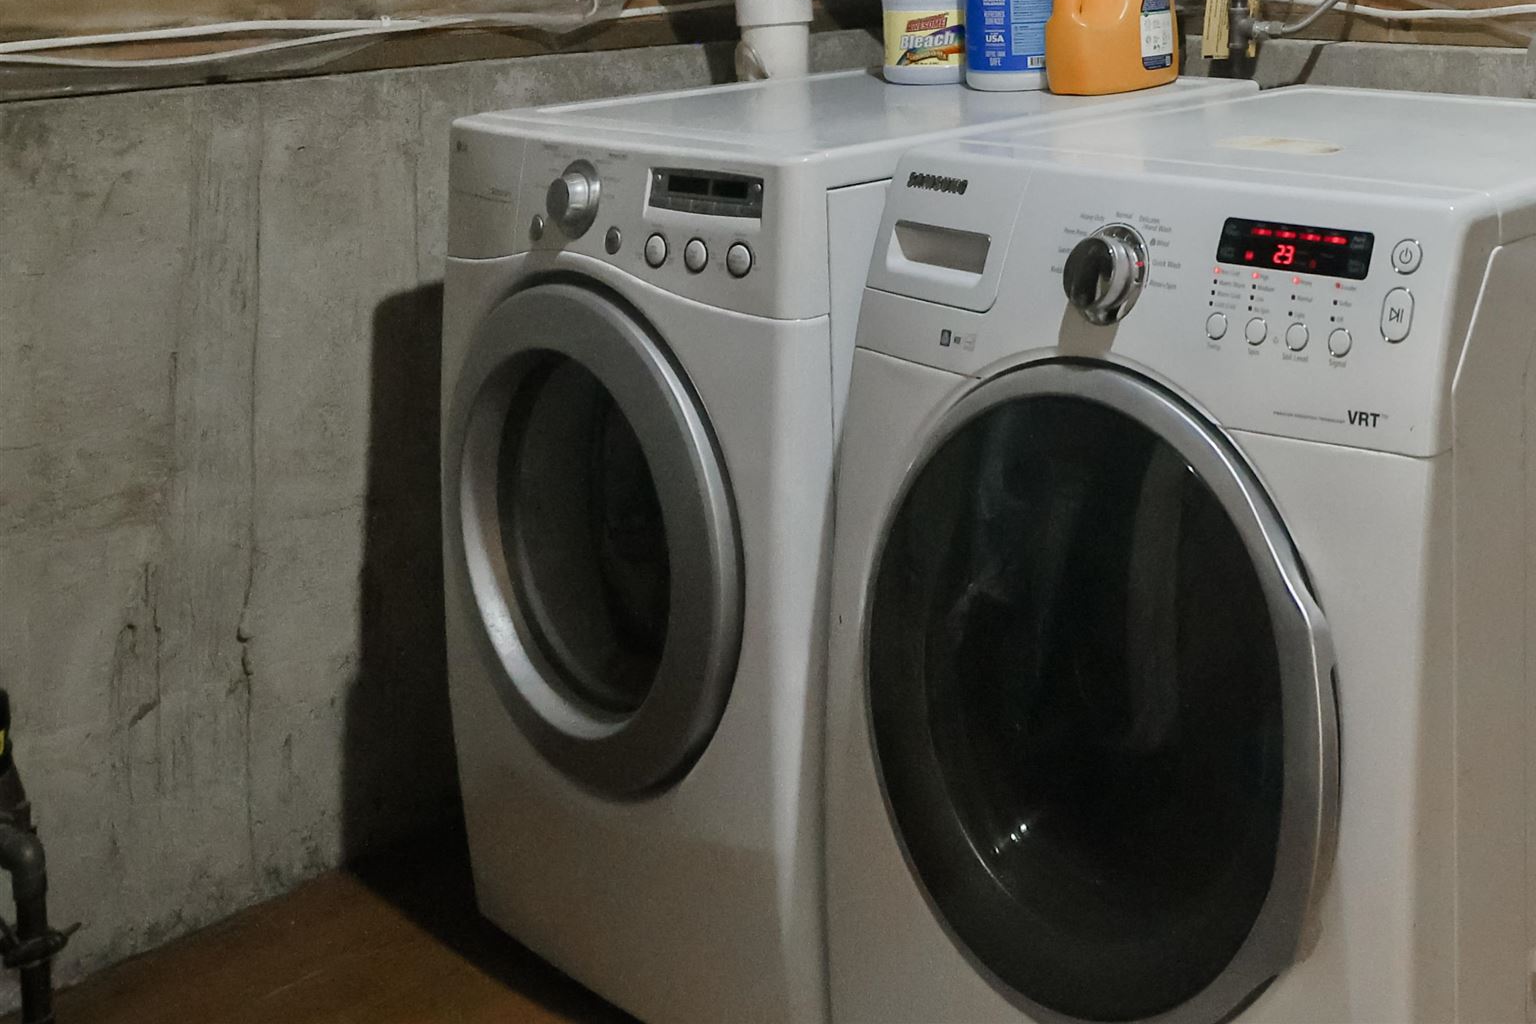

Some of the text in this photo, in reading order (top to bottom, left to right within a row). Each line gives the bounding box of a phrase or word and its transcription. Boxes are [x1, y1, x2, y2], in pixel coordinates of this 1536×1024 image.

[900, 30, 956, 50] Bleach
[985, 34, 1005, 43] USA
[907, 171, 969, 195] SAMSUNG
[1273, 244, 1296, 265] 23
